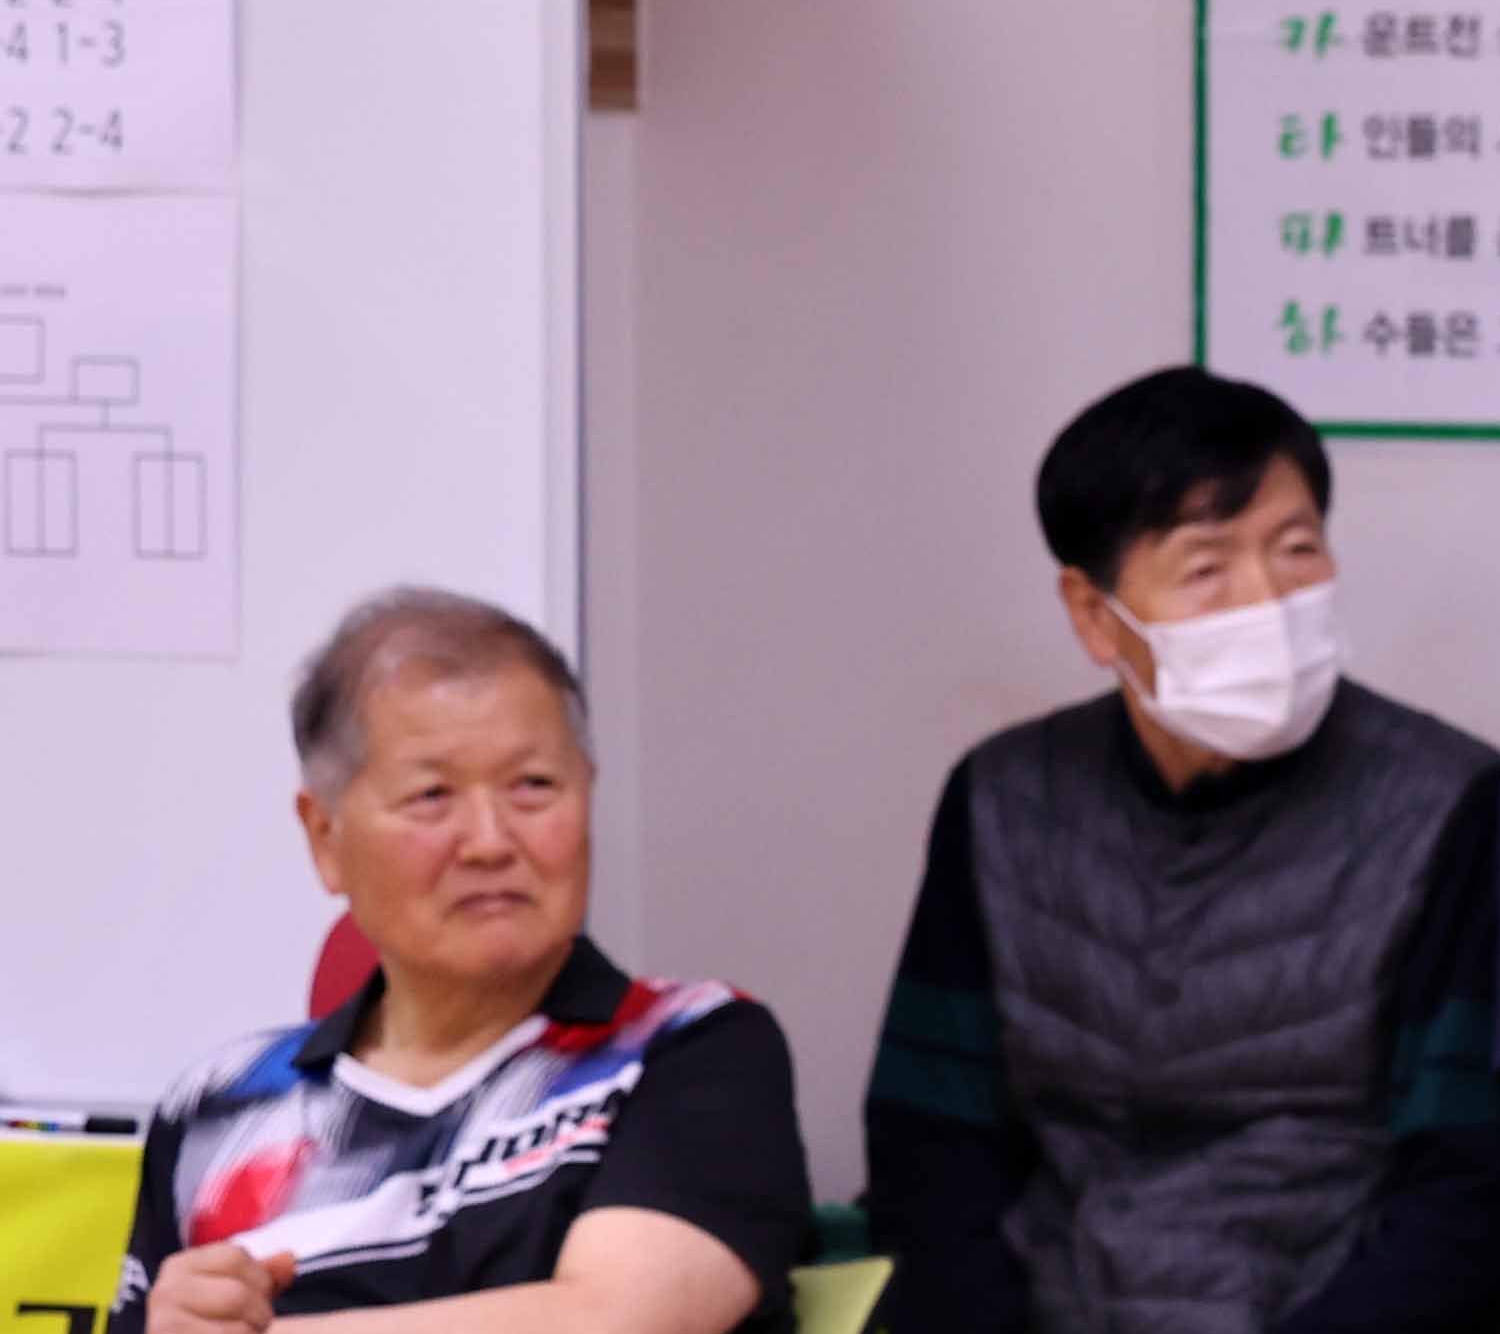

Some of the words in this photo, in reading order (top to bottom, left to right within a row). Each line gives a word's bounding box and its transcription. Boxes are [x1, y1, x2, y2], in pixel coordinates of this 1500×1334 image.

[56, 19, 125, 67] 1-3
[1360, 11, 1481, 59] 운트전
[53, 106, 124, 154] 2-4
[1363, 115, 1480, 160] 인들의
